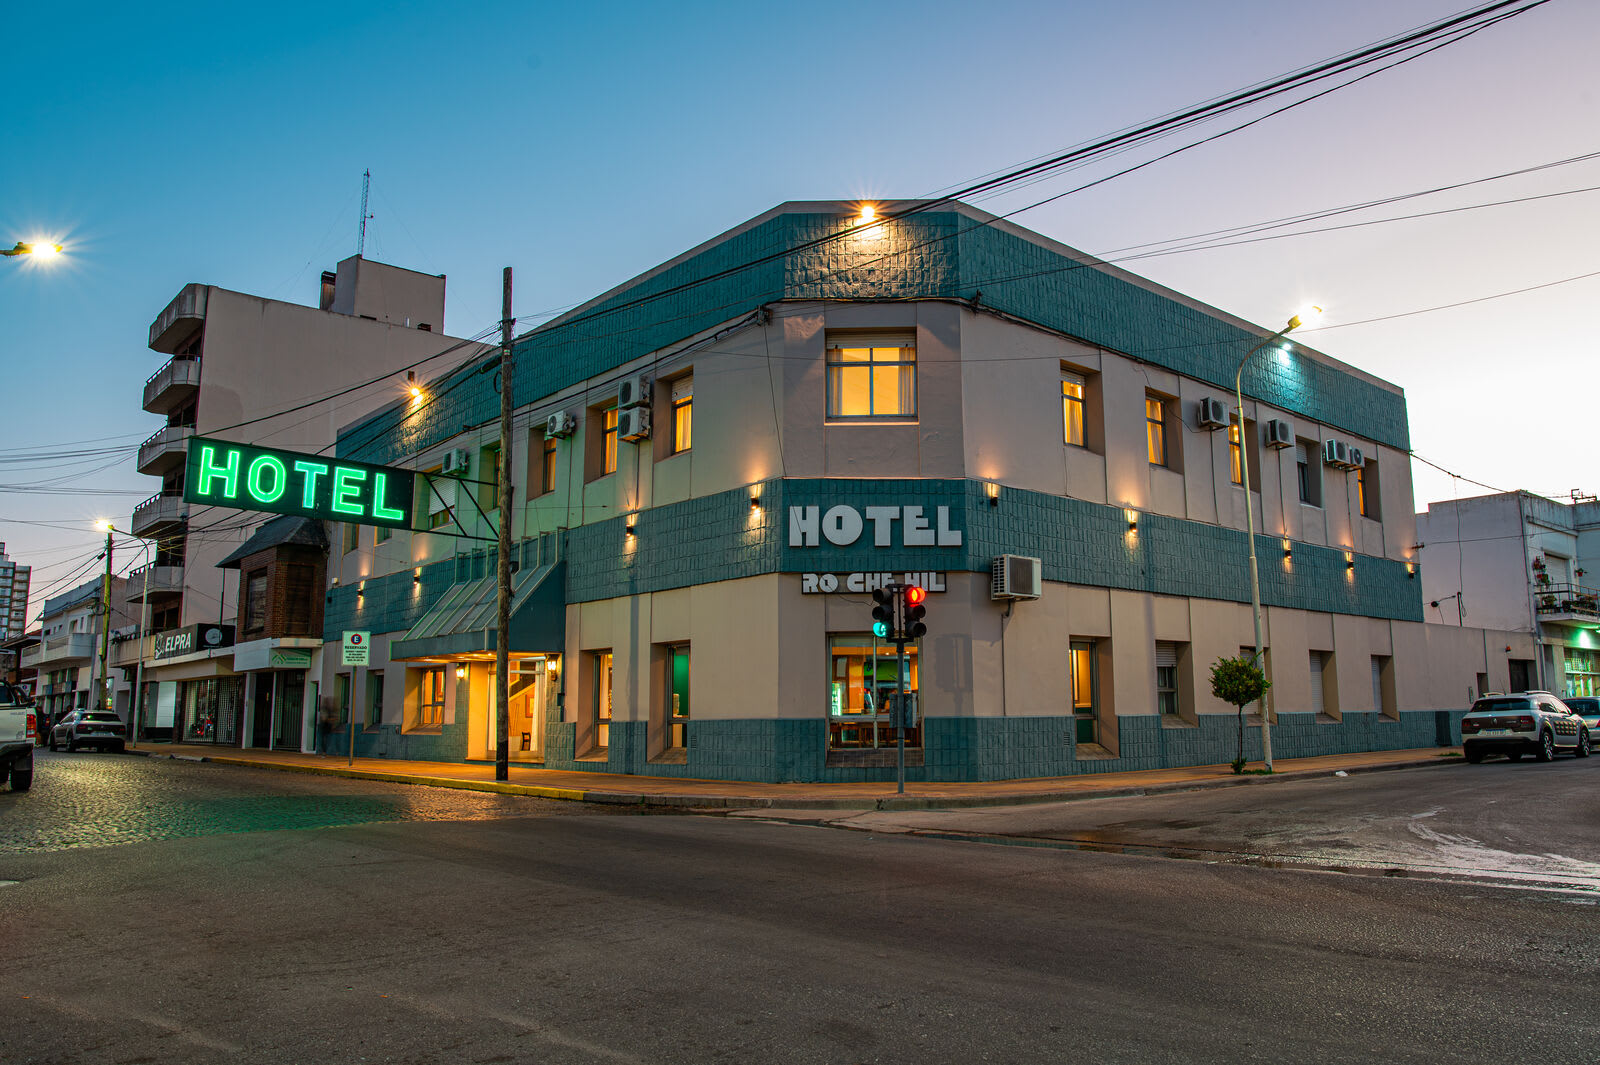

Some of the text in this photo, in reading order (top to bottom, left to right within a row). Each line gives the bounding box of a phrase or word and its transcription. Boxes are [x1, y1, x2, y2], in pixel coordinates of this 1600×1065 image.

[197, 447, 404, 521] HOTEL
[789, 504, 962, 547] HOTEL
[802, 572, 839, 593] RO
[165, 632, 191, 652] ELPRA
